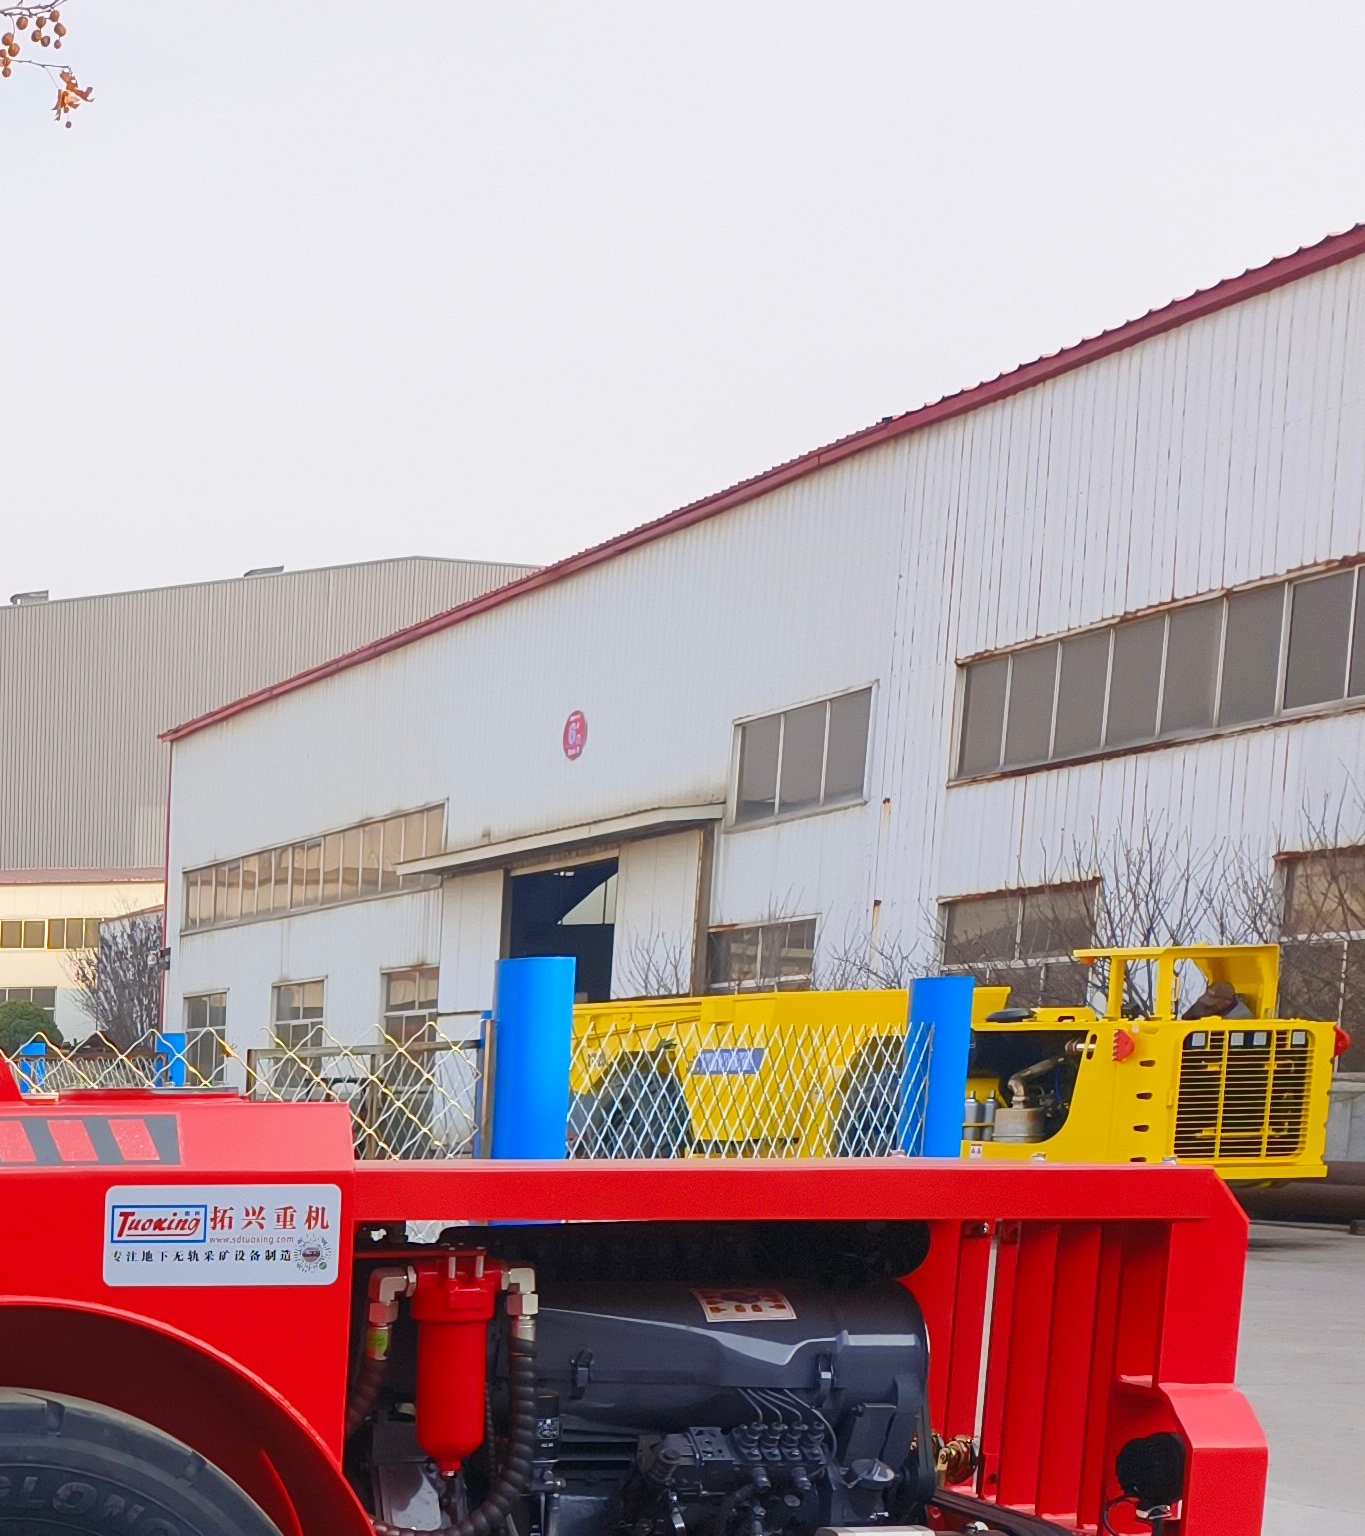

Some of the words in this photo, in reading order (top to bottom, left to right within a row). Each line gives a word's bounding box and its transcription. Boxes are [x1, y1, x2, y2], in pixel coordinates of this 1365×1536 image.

[117, 1211, 201, 1238] Tuoxing
[209, 1204, 330, 1231] 拓兴重机
[209, 1235, 294, 1245] www.sdtuoxing.com
[113, 1249, 292, 1262] 专注地下无轨采矿设备制造
